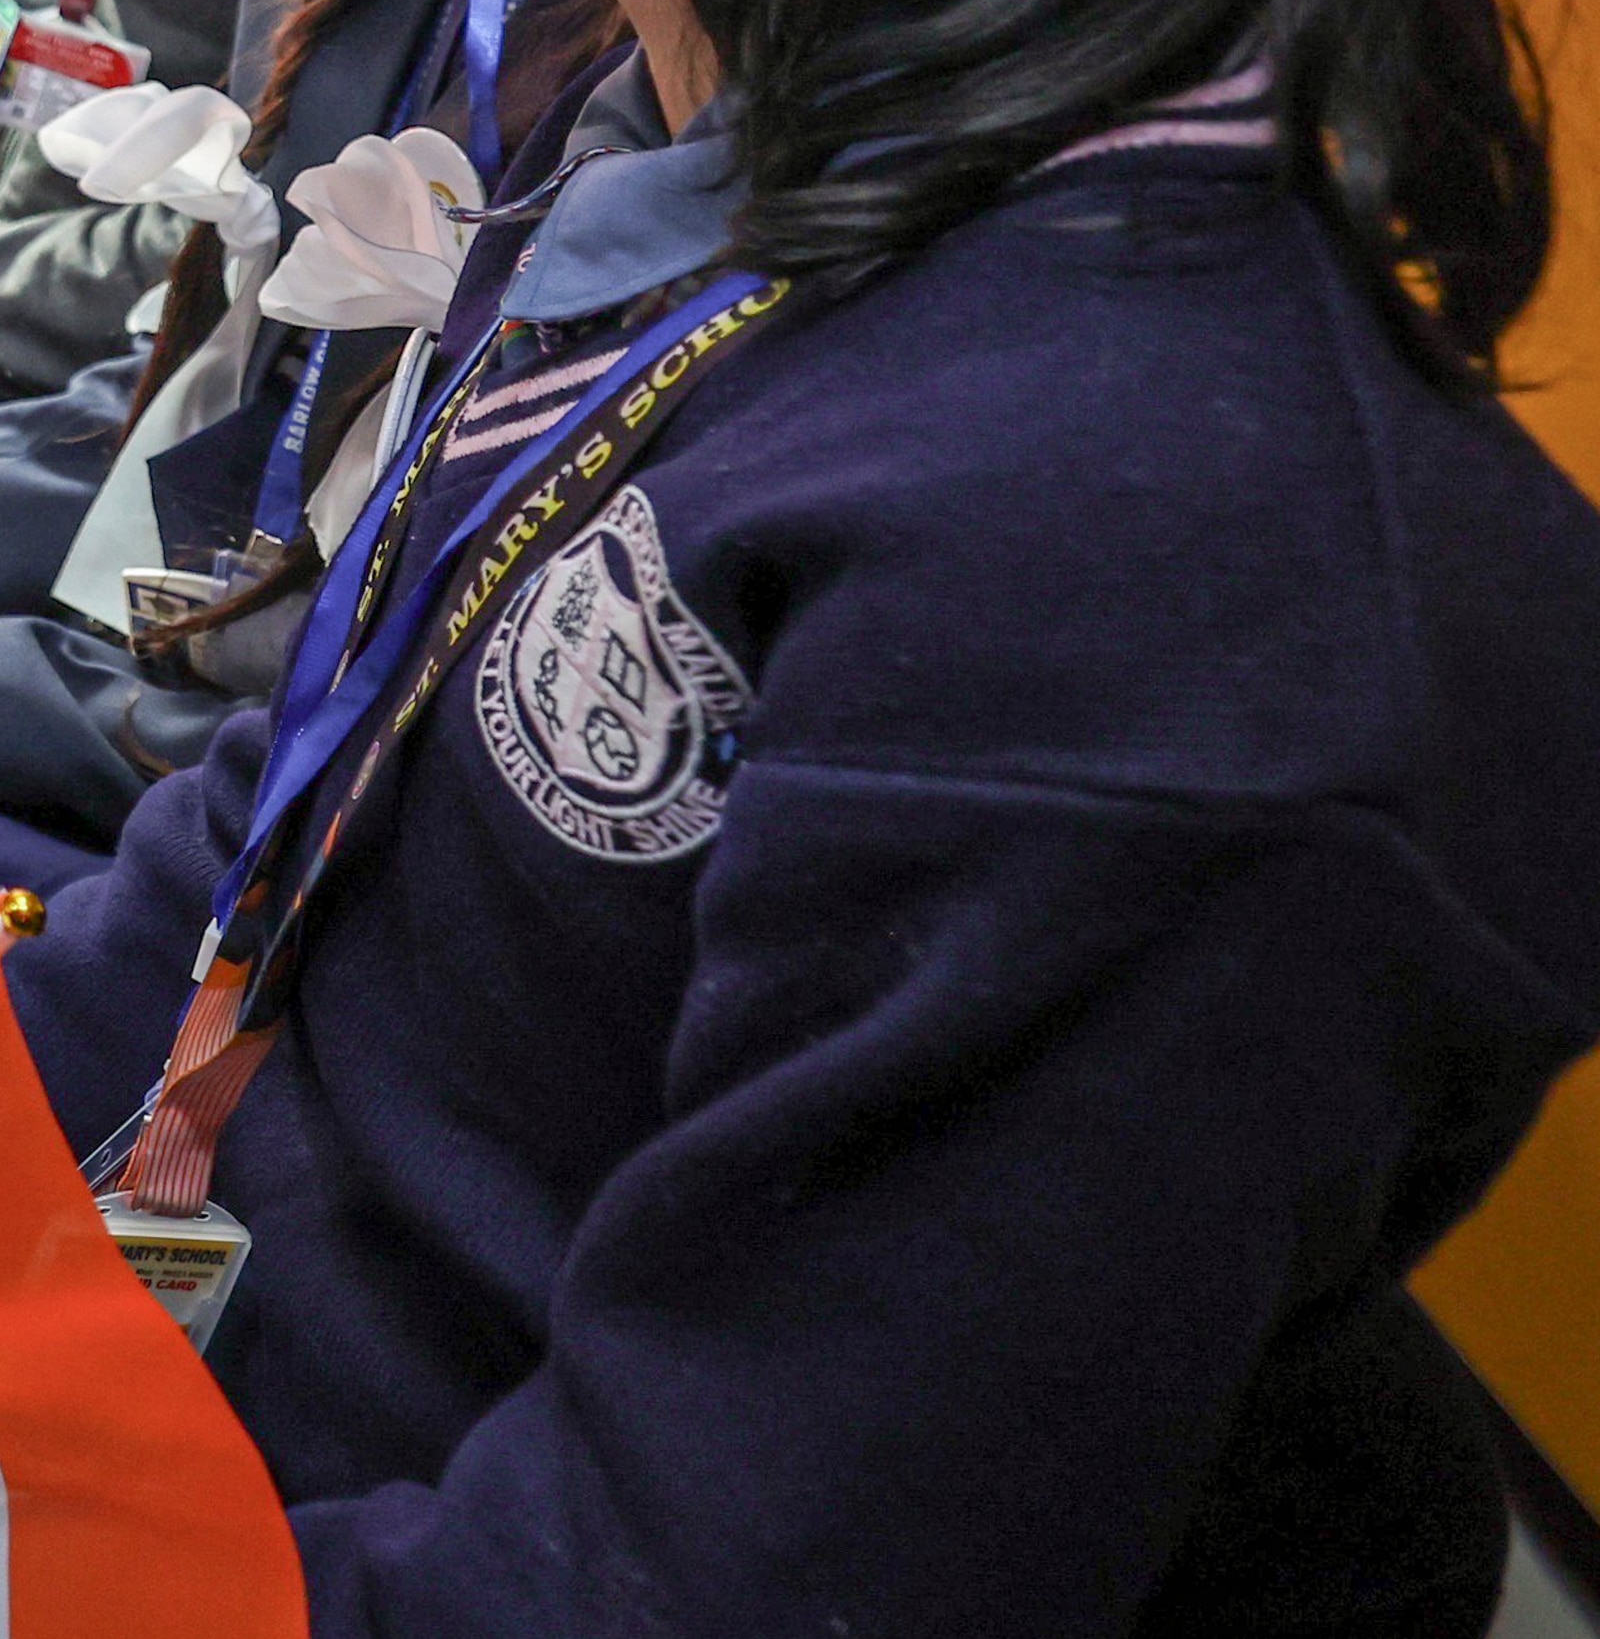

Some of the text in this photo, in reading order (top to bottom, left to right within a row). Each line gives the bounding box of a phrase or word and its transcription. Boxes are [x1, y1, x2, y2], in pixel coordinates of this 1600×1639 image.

[393, 656, 439, 733] ST.
[446, 433, 614, 646] MARY'S
[482, 688, 542, 792] YOUR
[534, 778, 616, 852] LIGHT
[623, 776, 728, 853] SHINE
[156, 1279, 197, 1291] CARD
[169, 1247, 226, 1265] SCHOOL
